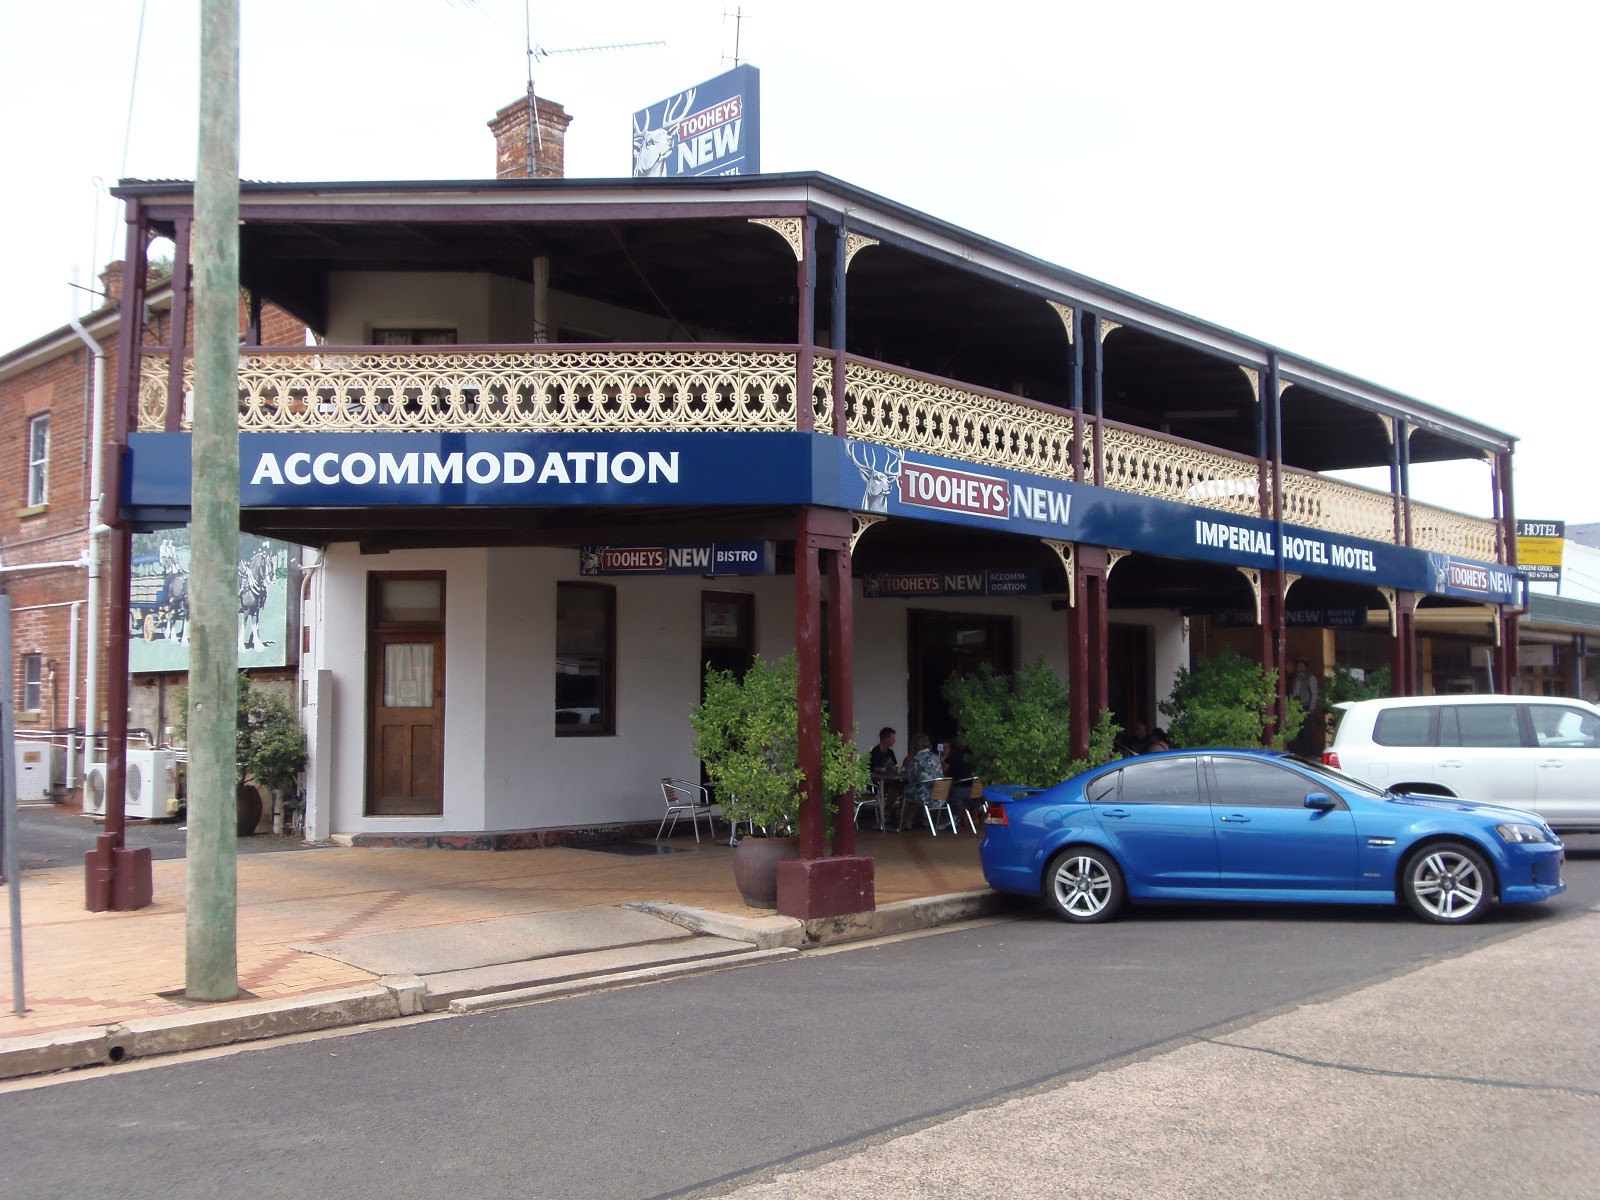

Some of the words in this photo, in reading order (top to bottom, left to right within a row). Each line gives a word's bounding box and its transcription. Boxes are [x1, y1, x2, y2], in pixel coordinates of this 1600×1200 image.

[681, 100, 738, 137] TOOHEYS
[677, 118, 742, 174] NEW
[250, 450, 680, 486] ACCOMMODATION
[904, 469, 1005, 512] TOOHEYS
[1013, 484, 1072, 526] NEW
[1523, 523, 1560, 536] HOTEL
[605, 551, 663, 567] TOOHEYS
[668, 548, 711, 567] NEW
[717, 550, 758, 562] BISTRO
[1195, 519, 1275, 556] IMPERIAL
[1282, 535, 1329, 565] HOTEL
[1332, 543, 1377, 573] MOTEL
[885, 576, 939, 591] TOOHEYS
[944, 574, 983, 591] NEW
[990, 573, 1028, 582] ACCOMM-
[991, 582, 1026, 591] ODATION
[1449, 565, 1488, 589] TOOHEYS
[1490, 571, 1513, 593] NEW
[1286, 610, 1320, 623] NEW
